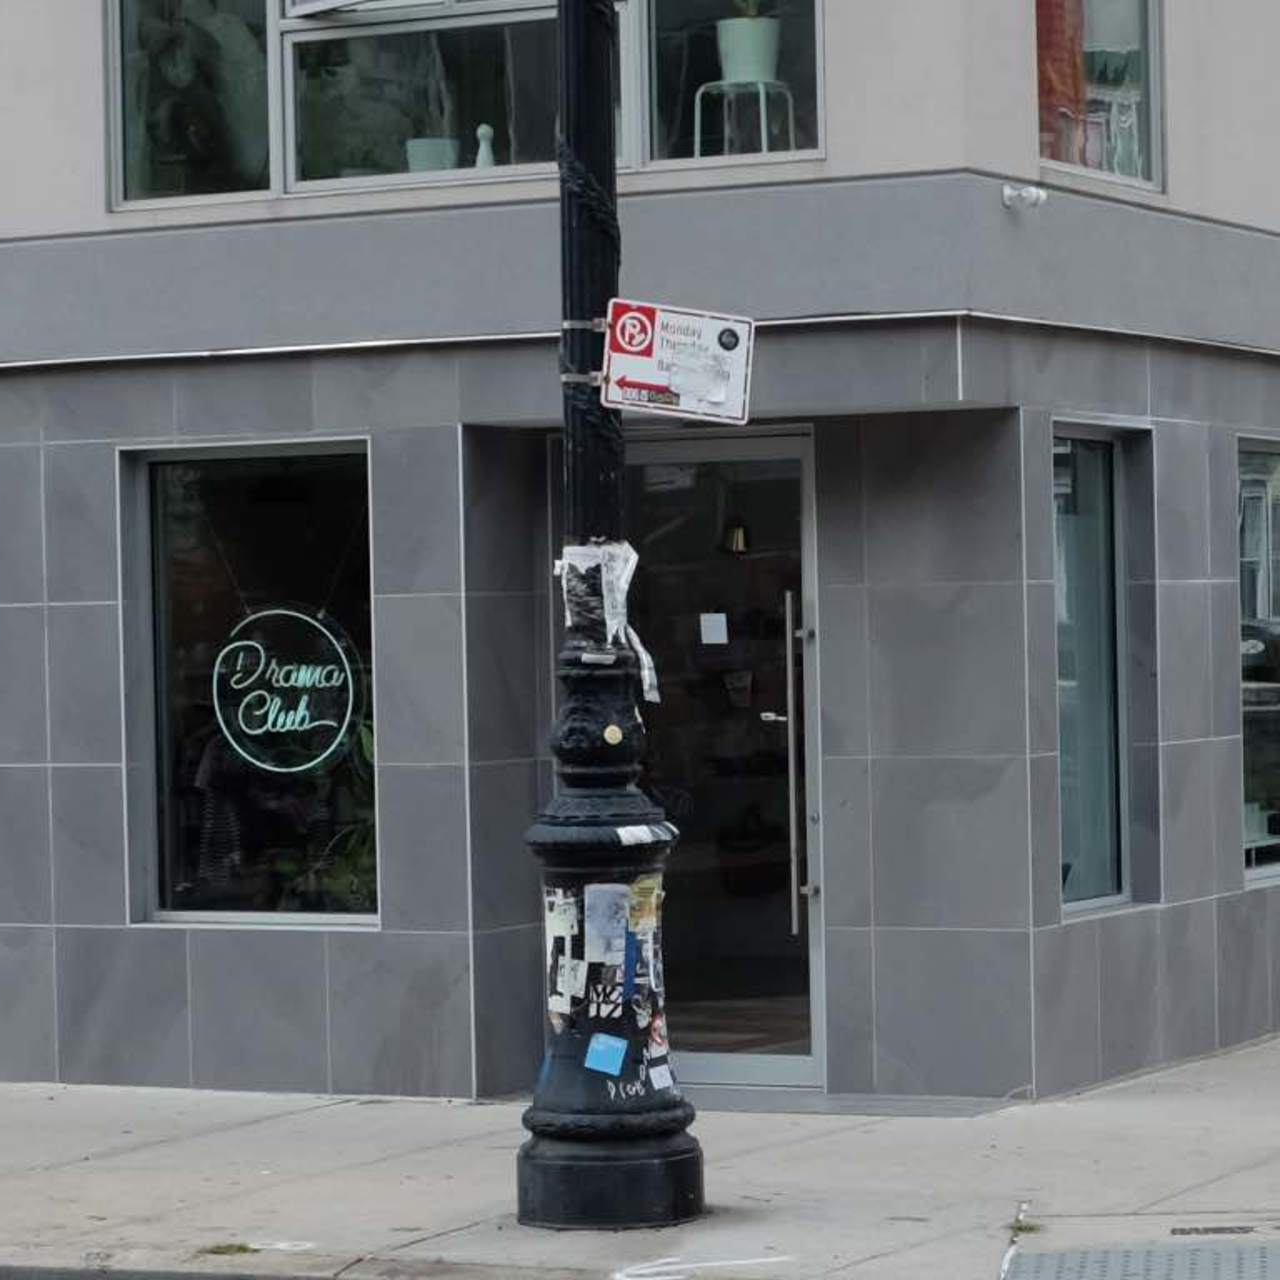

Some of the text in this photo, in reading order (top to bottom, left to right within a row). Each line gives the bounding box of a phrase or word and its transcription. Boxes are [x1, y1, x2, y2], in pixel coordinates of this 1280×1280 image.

[661, 319, 703, 340] Monday
[216, 640, 346, 690] Drama
[238, 689, 338, 736] Club
